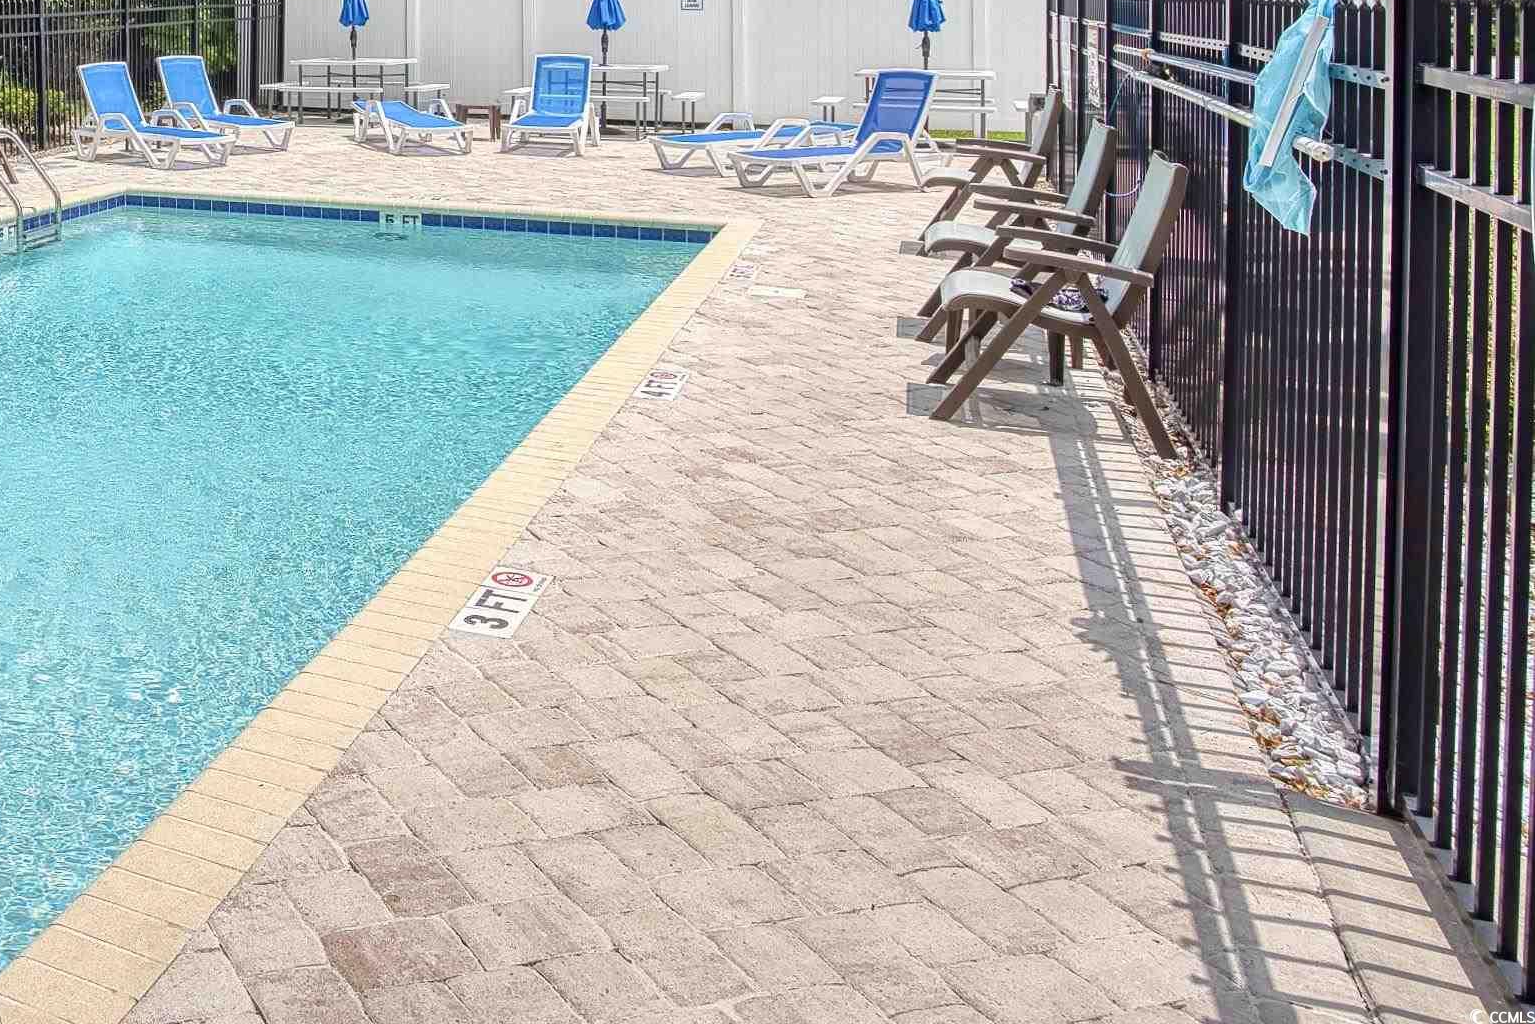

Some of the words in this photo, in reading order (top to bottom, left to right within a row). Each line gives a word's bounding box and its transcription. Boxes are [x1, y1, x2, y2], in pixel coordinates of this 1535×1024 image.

[402, 215, 420, 225] FT
[474, 588, 528, 614] FT
[463, 614, 509, 630] 3
